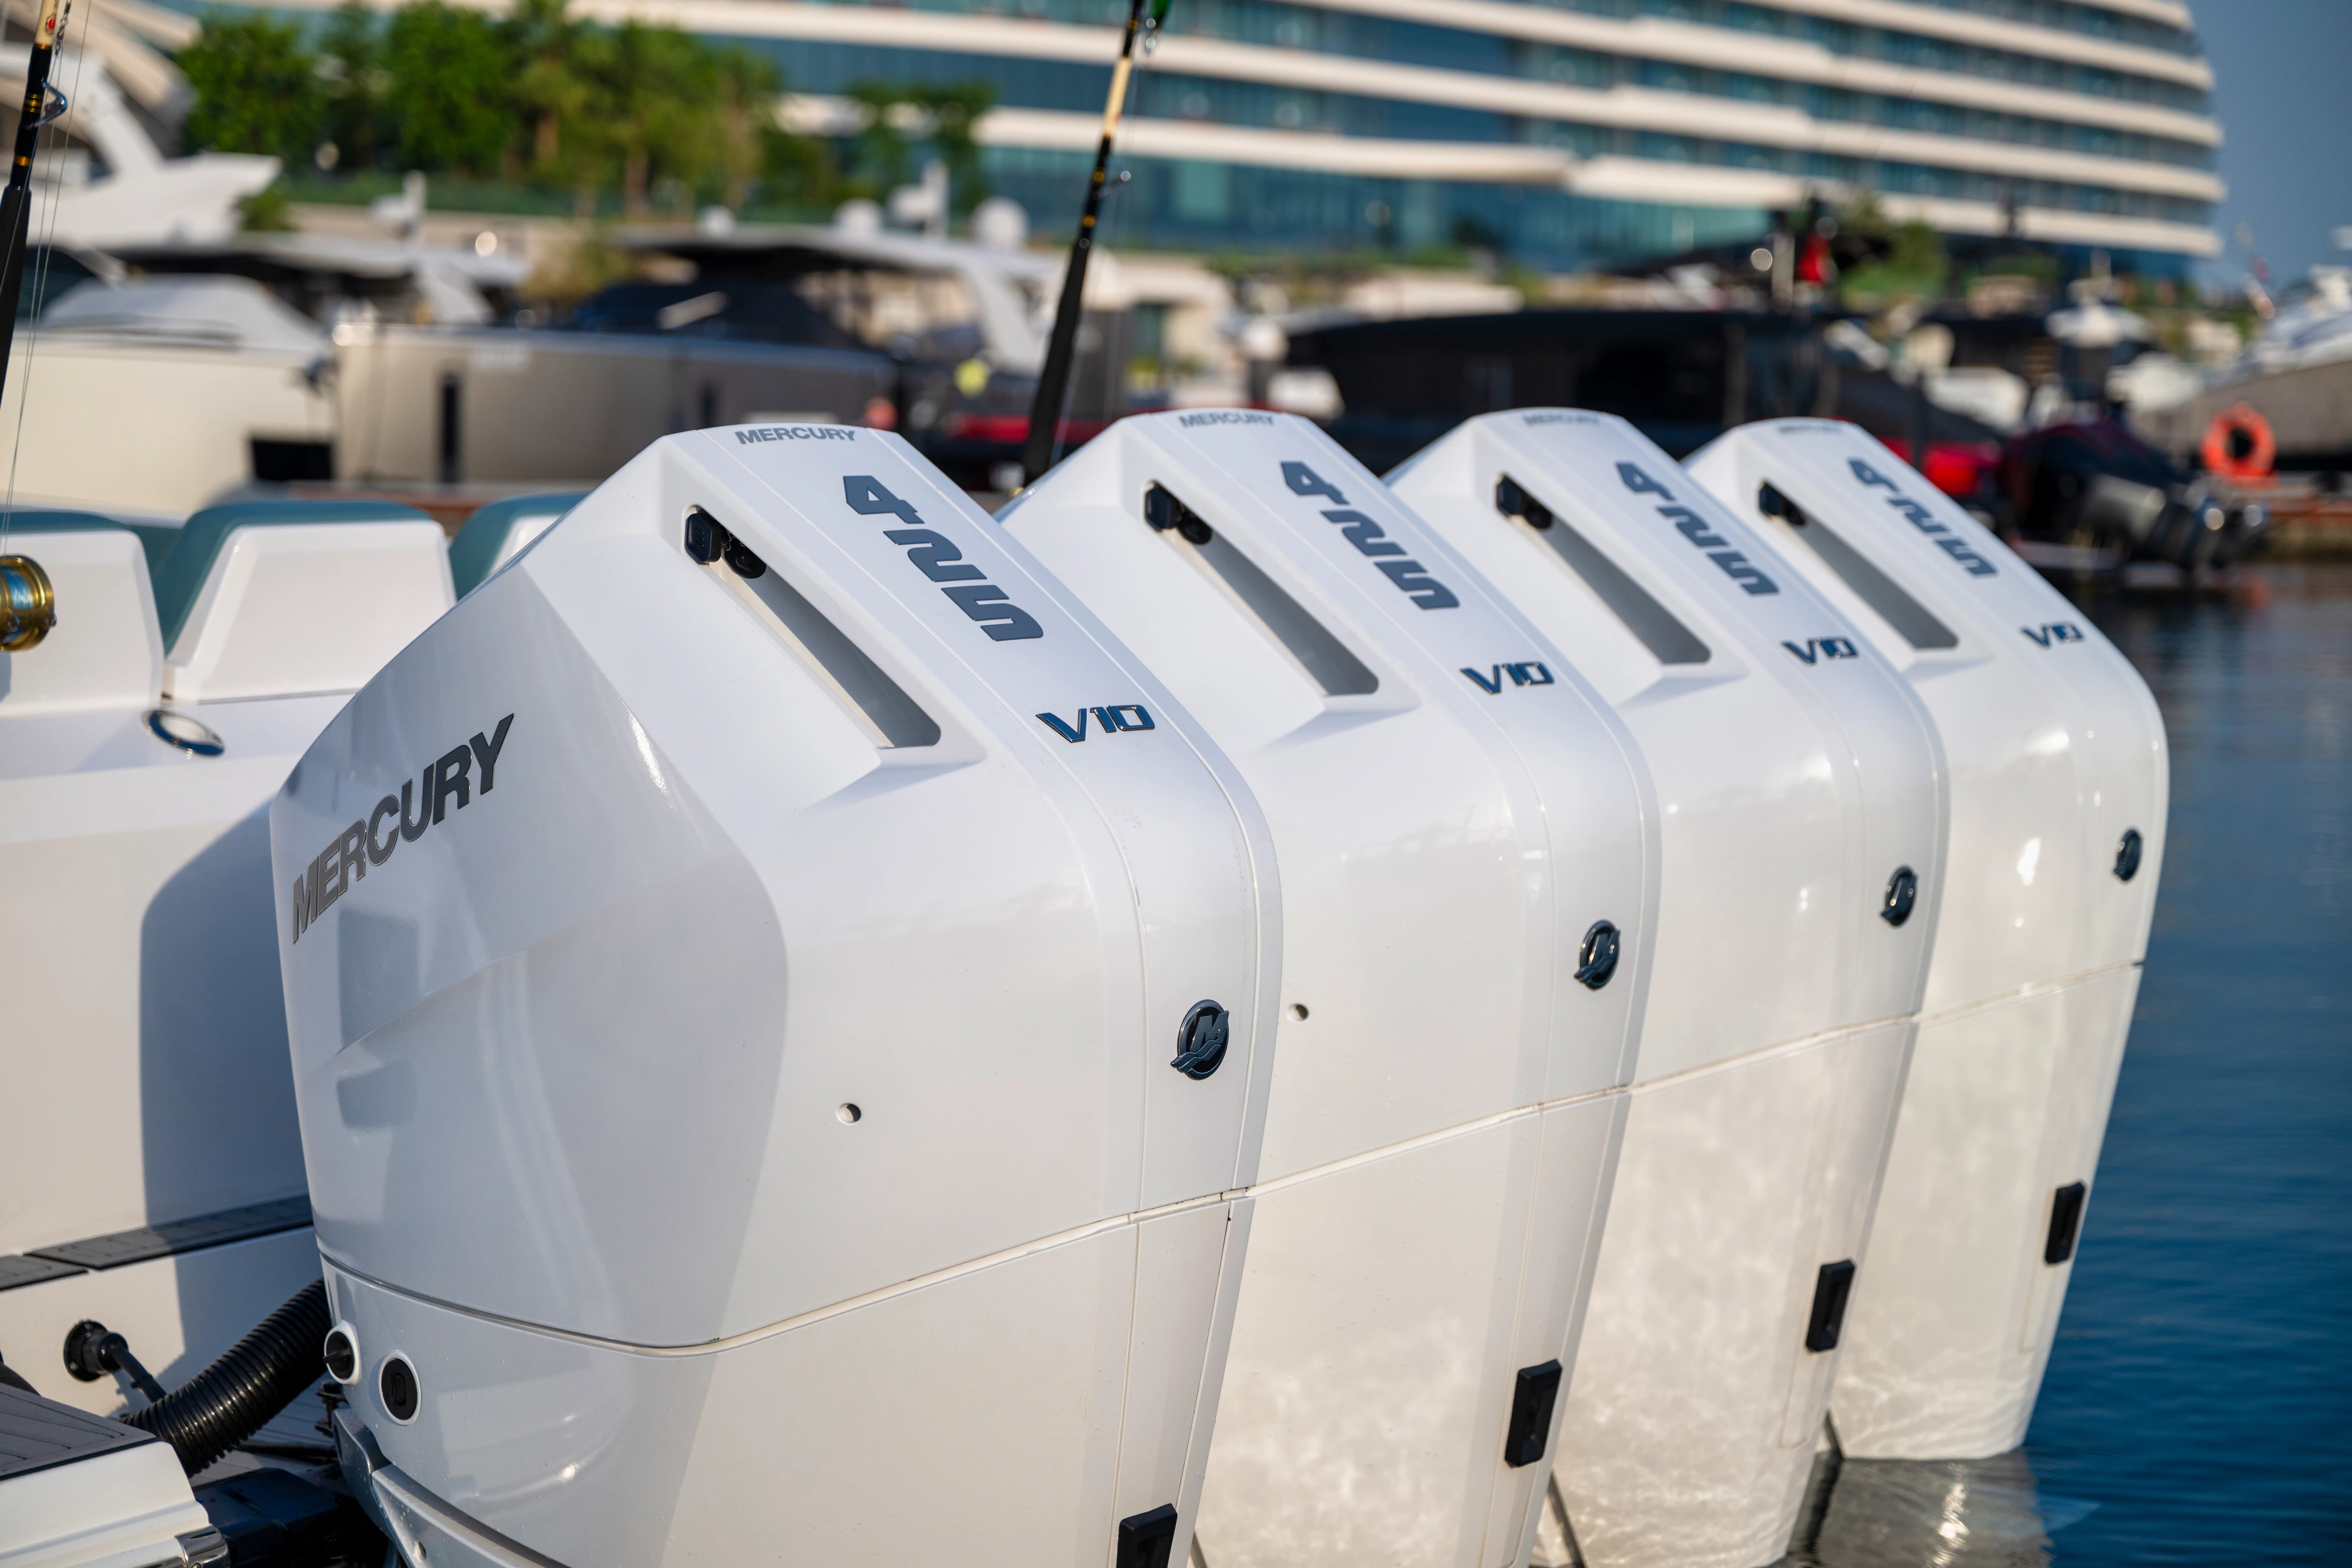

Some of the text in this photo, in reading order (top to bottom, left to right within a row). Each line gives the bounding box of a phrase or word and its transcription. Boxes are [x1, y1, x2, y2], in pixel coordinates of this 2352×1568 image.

[735, 428, 856, 445] MERCURY
[1178, 412, 1274, 428] MERCURY
[1280, 461, 1460, 610] 425
[1616, 462, 1780, 596] 425
[1849, 458, 1998, 577] 425
[843, 475, 1044, 642] 425
[1460, 662, 1555, 695] V10
[1781, 637, 1859, 665] V10
[1035, 704, 1156, 743] V10
[293, 713, 515, 945] MERCURY
